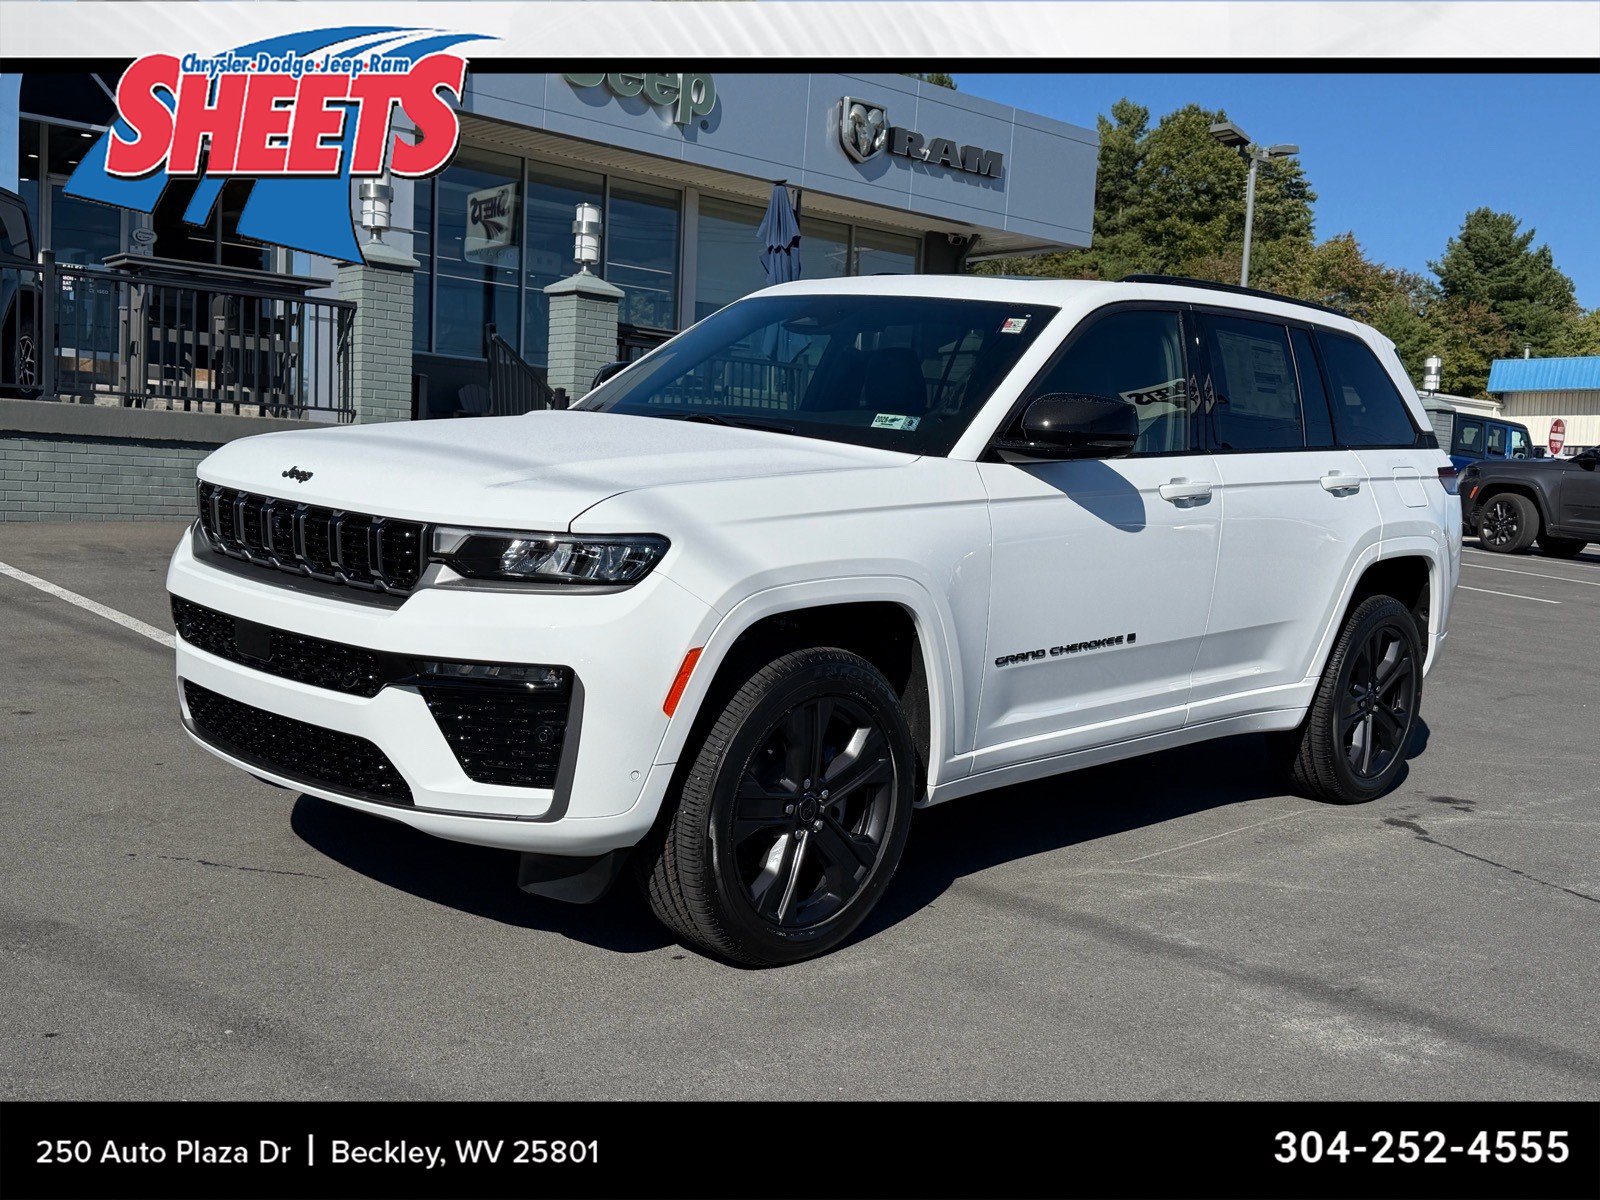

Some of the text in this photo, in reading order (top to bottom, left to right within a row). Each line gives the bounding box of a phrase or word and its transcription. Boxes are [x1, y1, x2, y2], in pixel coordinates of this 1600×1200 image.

[561, 73, 716, 125] eep
[888, 126, 1004, 179] RAM
[281, 465, 314, 484] Jeep
[994, 634, 1124, 667] GRAND CHEROKEE
